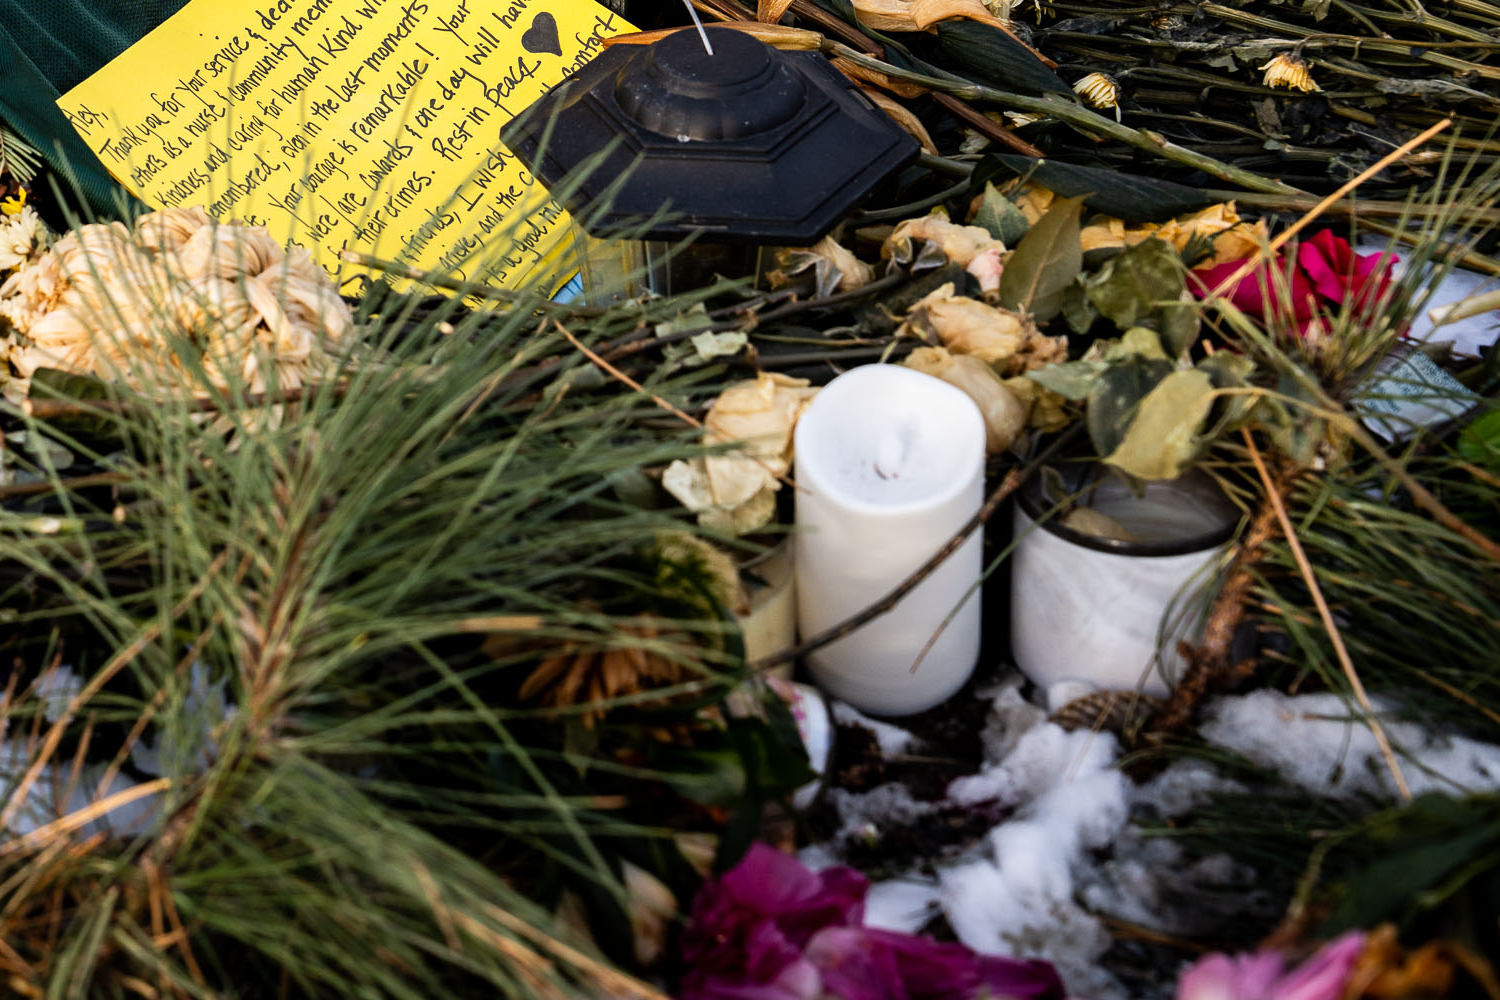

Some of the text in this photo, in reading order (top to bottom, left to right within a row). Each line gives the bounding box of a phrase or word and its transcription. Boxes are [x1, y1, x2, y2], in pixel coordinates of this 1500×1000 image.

[204, 35, 250, 78] service
[150, 92, 186, 118] for
[324, 65, 366, 103] last
[414, 98, 446, 129] one
[435, 66, 487, 101] day
[131, 153, 168, 188] others
[163, 140, 184, 161] as
[184, 104, 227, 139] nurse
[230, 35, 311, 103] community
[139, 113, 170, 146] you
[203, 142, 234, 174] and
[228, 115, 283, 151] caring
[271, 56, 330, 106] human
[302, 118, 323, 138] in
[310, 95, 340, 124] the
[99, 126, 148, 163] Thank
[298, 149, 351, 194] courage
[339, 138, 358, 157] is
[353, 209, 388, 245] their
[432, 119, 474, 162] Rest
[461, 106, 491, 126] in
[477, 204, 505, 234] and
[495, 184, 524, 210] the
